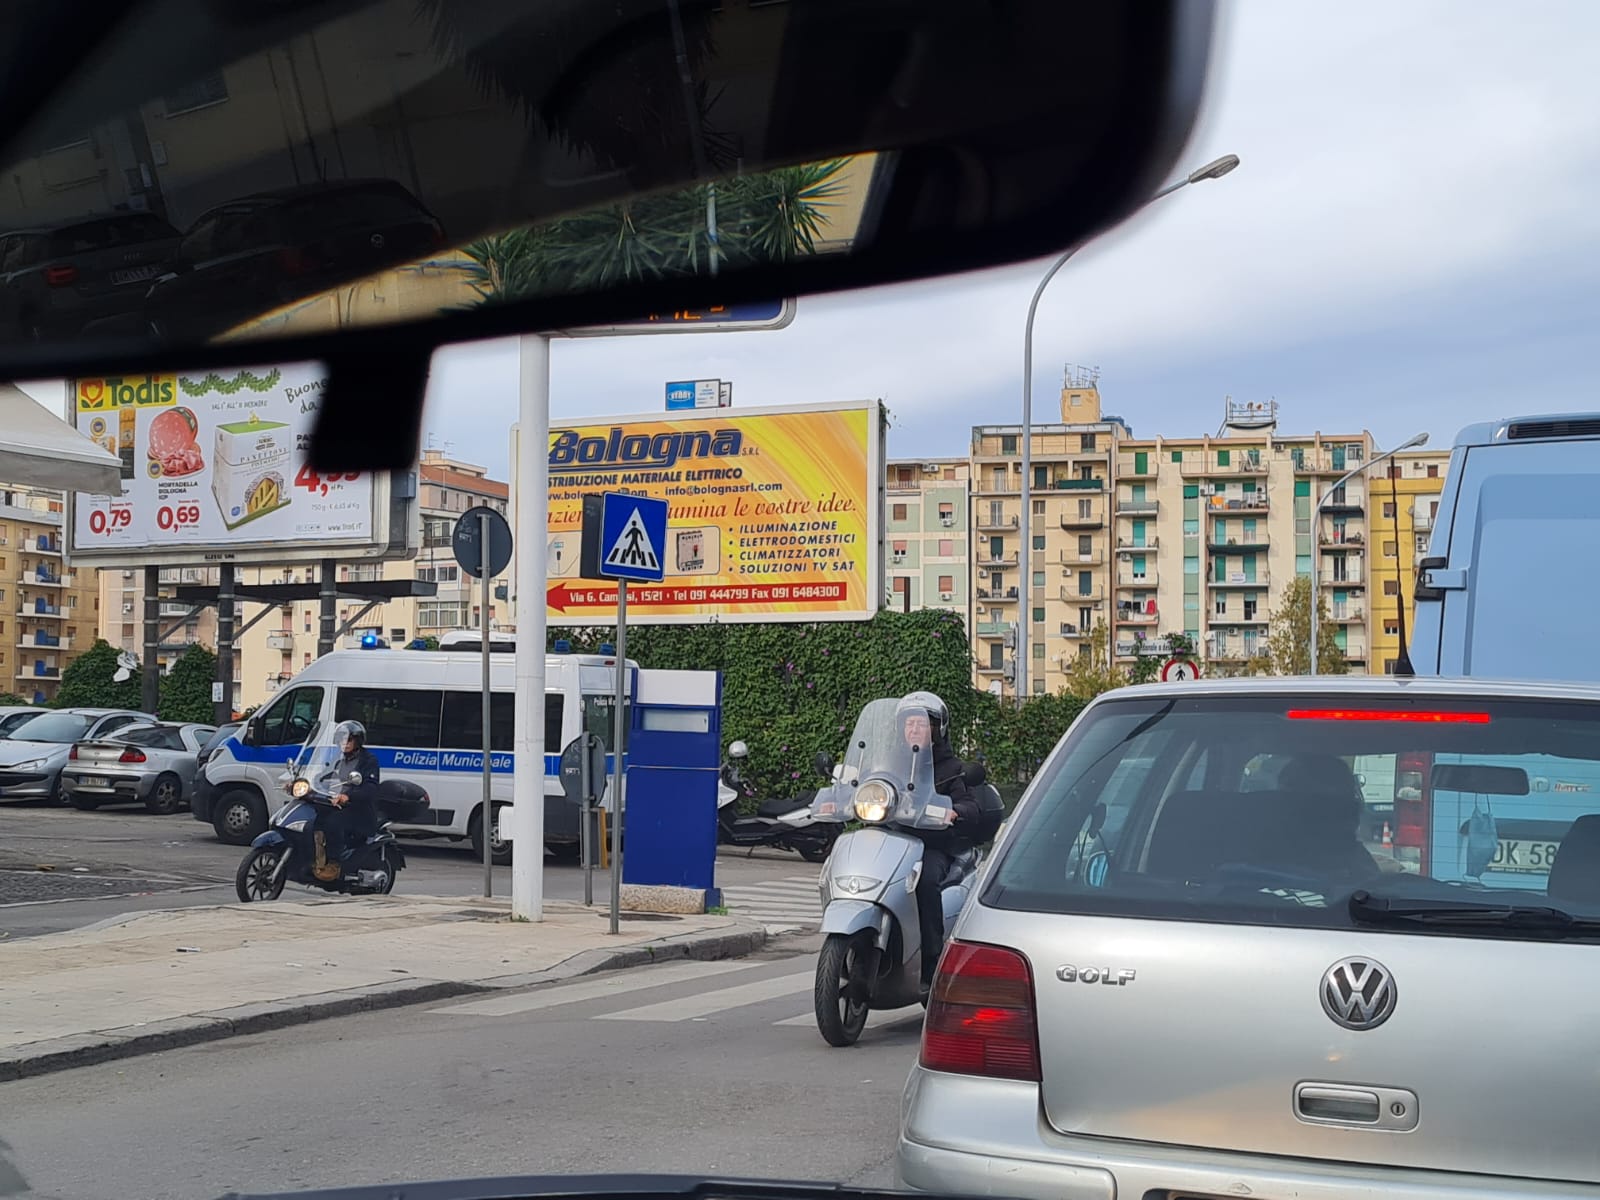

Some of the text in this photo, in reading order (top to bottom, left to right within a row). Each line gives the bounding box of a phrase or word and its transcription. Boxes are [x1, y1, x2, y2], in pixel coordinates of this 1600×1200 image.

[105, 376, 173, 406] Todis
[548, 427, 743, 470] Bologna
[621, 471, 682, 484] MATERIALE
[685, 468, 743, 481] ELETTRICO
[665, 482, 783, 496] info@bolognasrl.com
[733, 497, 749, 516] le
[755, 498, 811, 515] vostre
[816, 492, 857, 512] idee.
[89, 509, 132, 537] 0,79
[157, 506, 200, 533] 0,69
[739, 521, 838, 534] ILLUMINAZIONE
[739, 533, 856, 547] ELETTRODOMESTICI
[739, 548, 841, 561] CLIMATIZZATORI
[739, 561, 855, 574] SOLUZIONI TV SAT
[570, 585, 840, 603] Via G. Camsi, 15/21 Tel 091 444799 Fax 091 6484300
[393, 751, 511, 769] Polizia Municiale
[1056, 963, 1137, 986] GOLF
